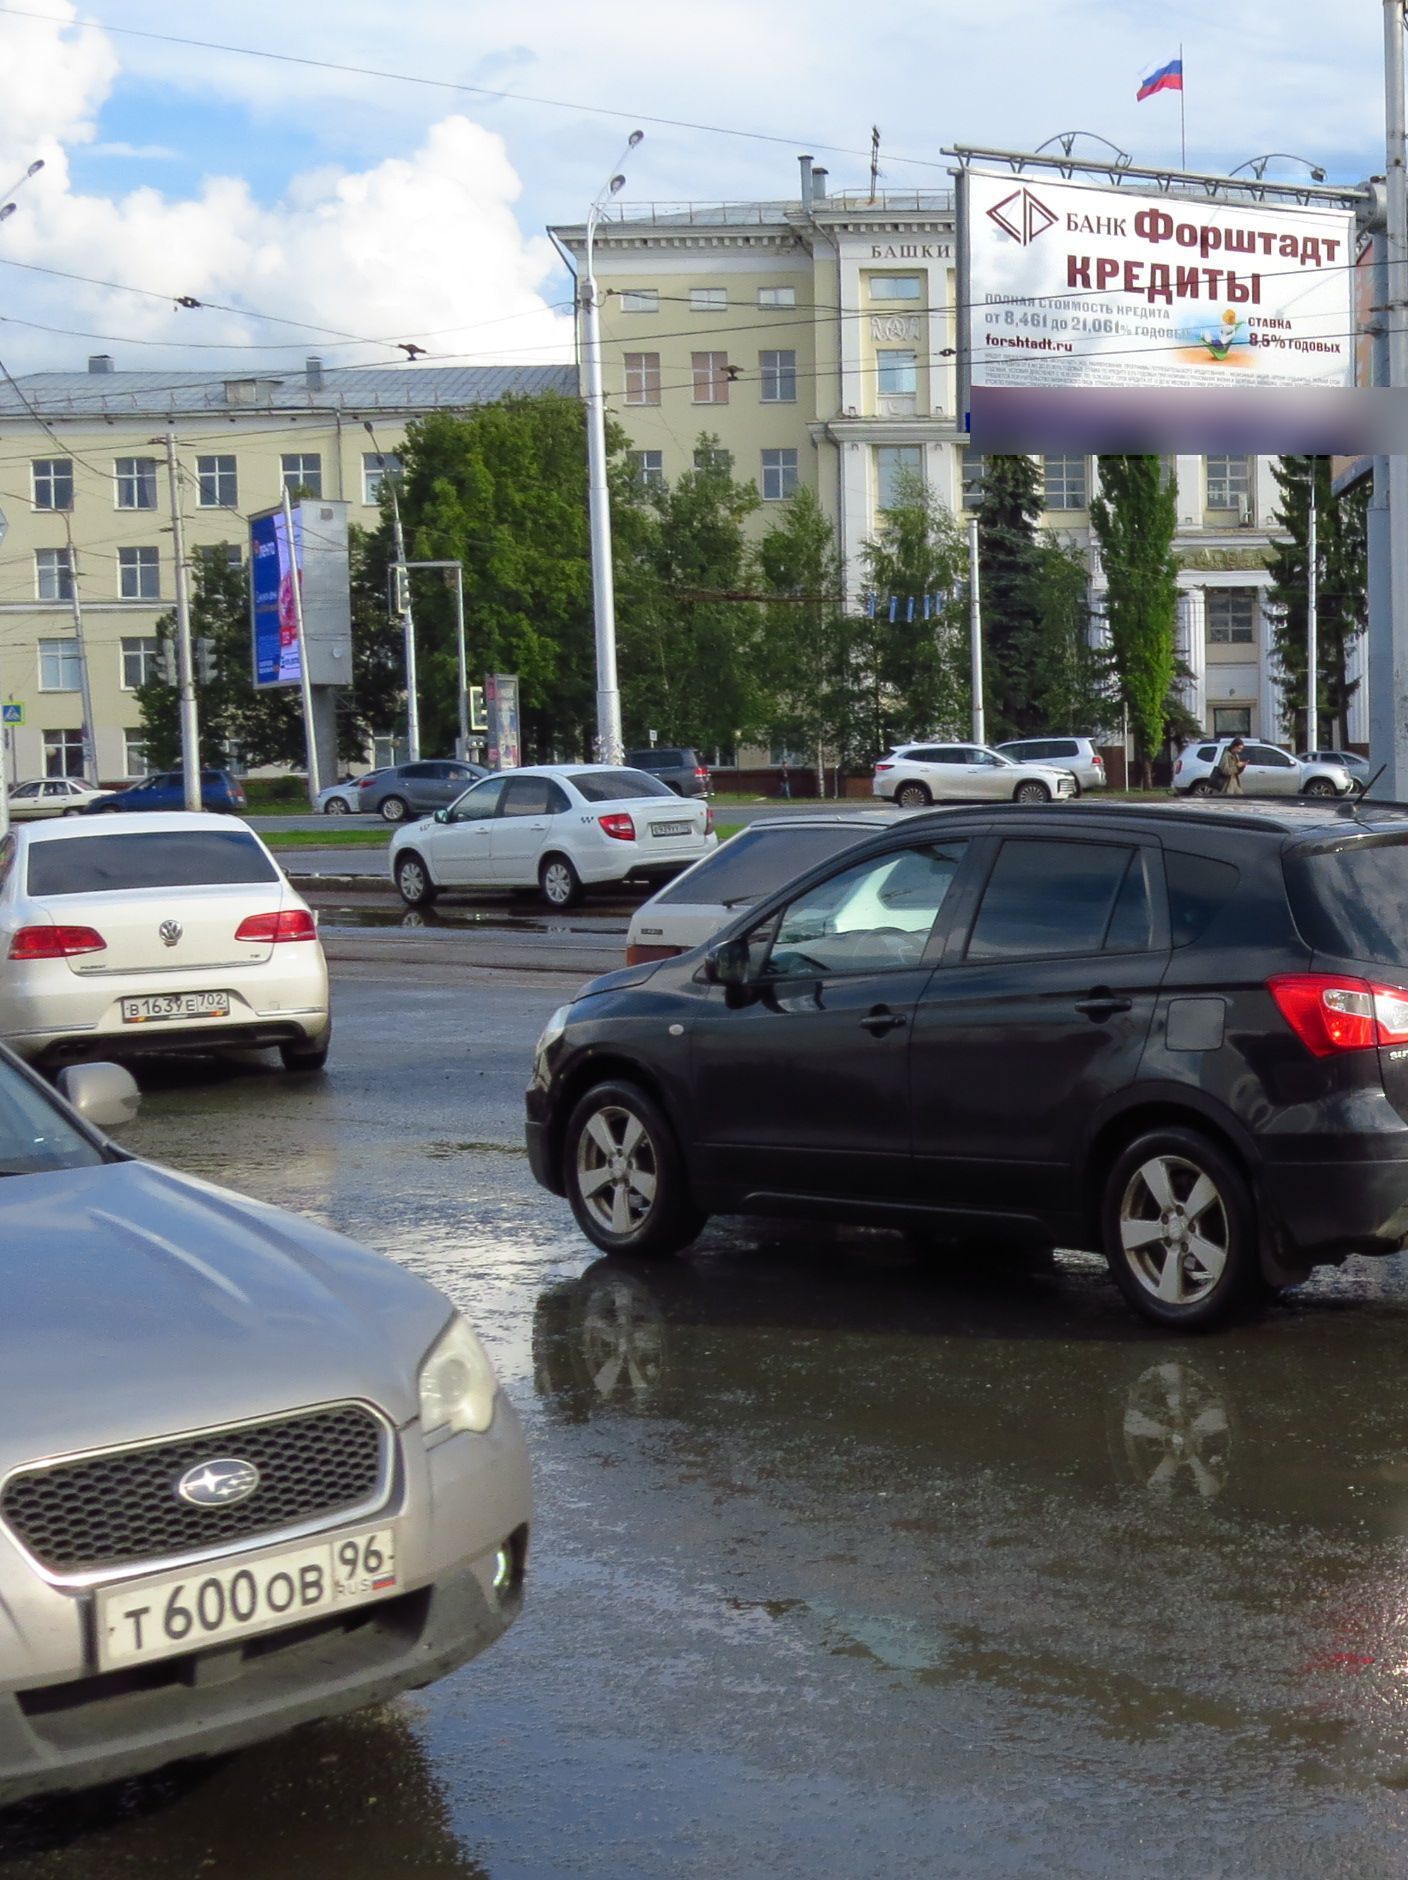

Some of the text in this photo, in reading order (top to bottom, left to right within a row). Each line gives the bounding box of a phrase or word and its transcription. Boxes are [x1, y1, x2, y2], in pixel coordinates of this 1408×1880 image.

[1066, 208, 1341, 267] БАНК Форштадт
[1067, 255, 1261, 305] КРЕДИТЫ
[1039, 297, 1113, 314] СТОИМОСТЬ
[1116, 305, 1170, 319] КРЕДИТА
[1248, 317, 1292, 330] СТАВКА
[985, 333, 1073, 352] forshtadt.ru
[198, 994, 224, 1006] 702
[124, 1535, 383, 1650] Т600ОВ 96
